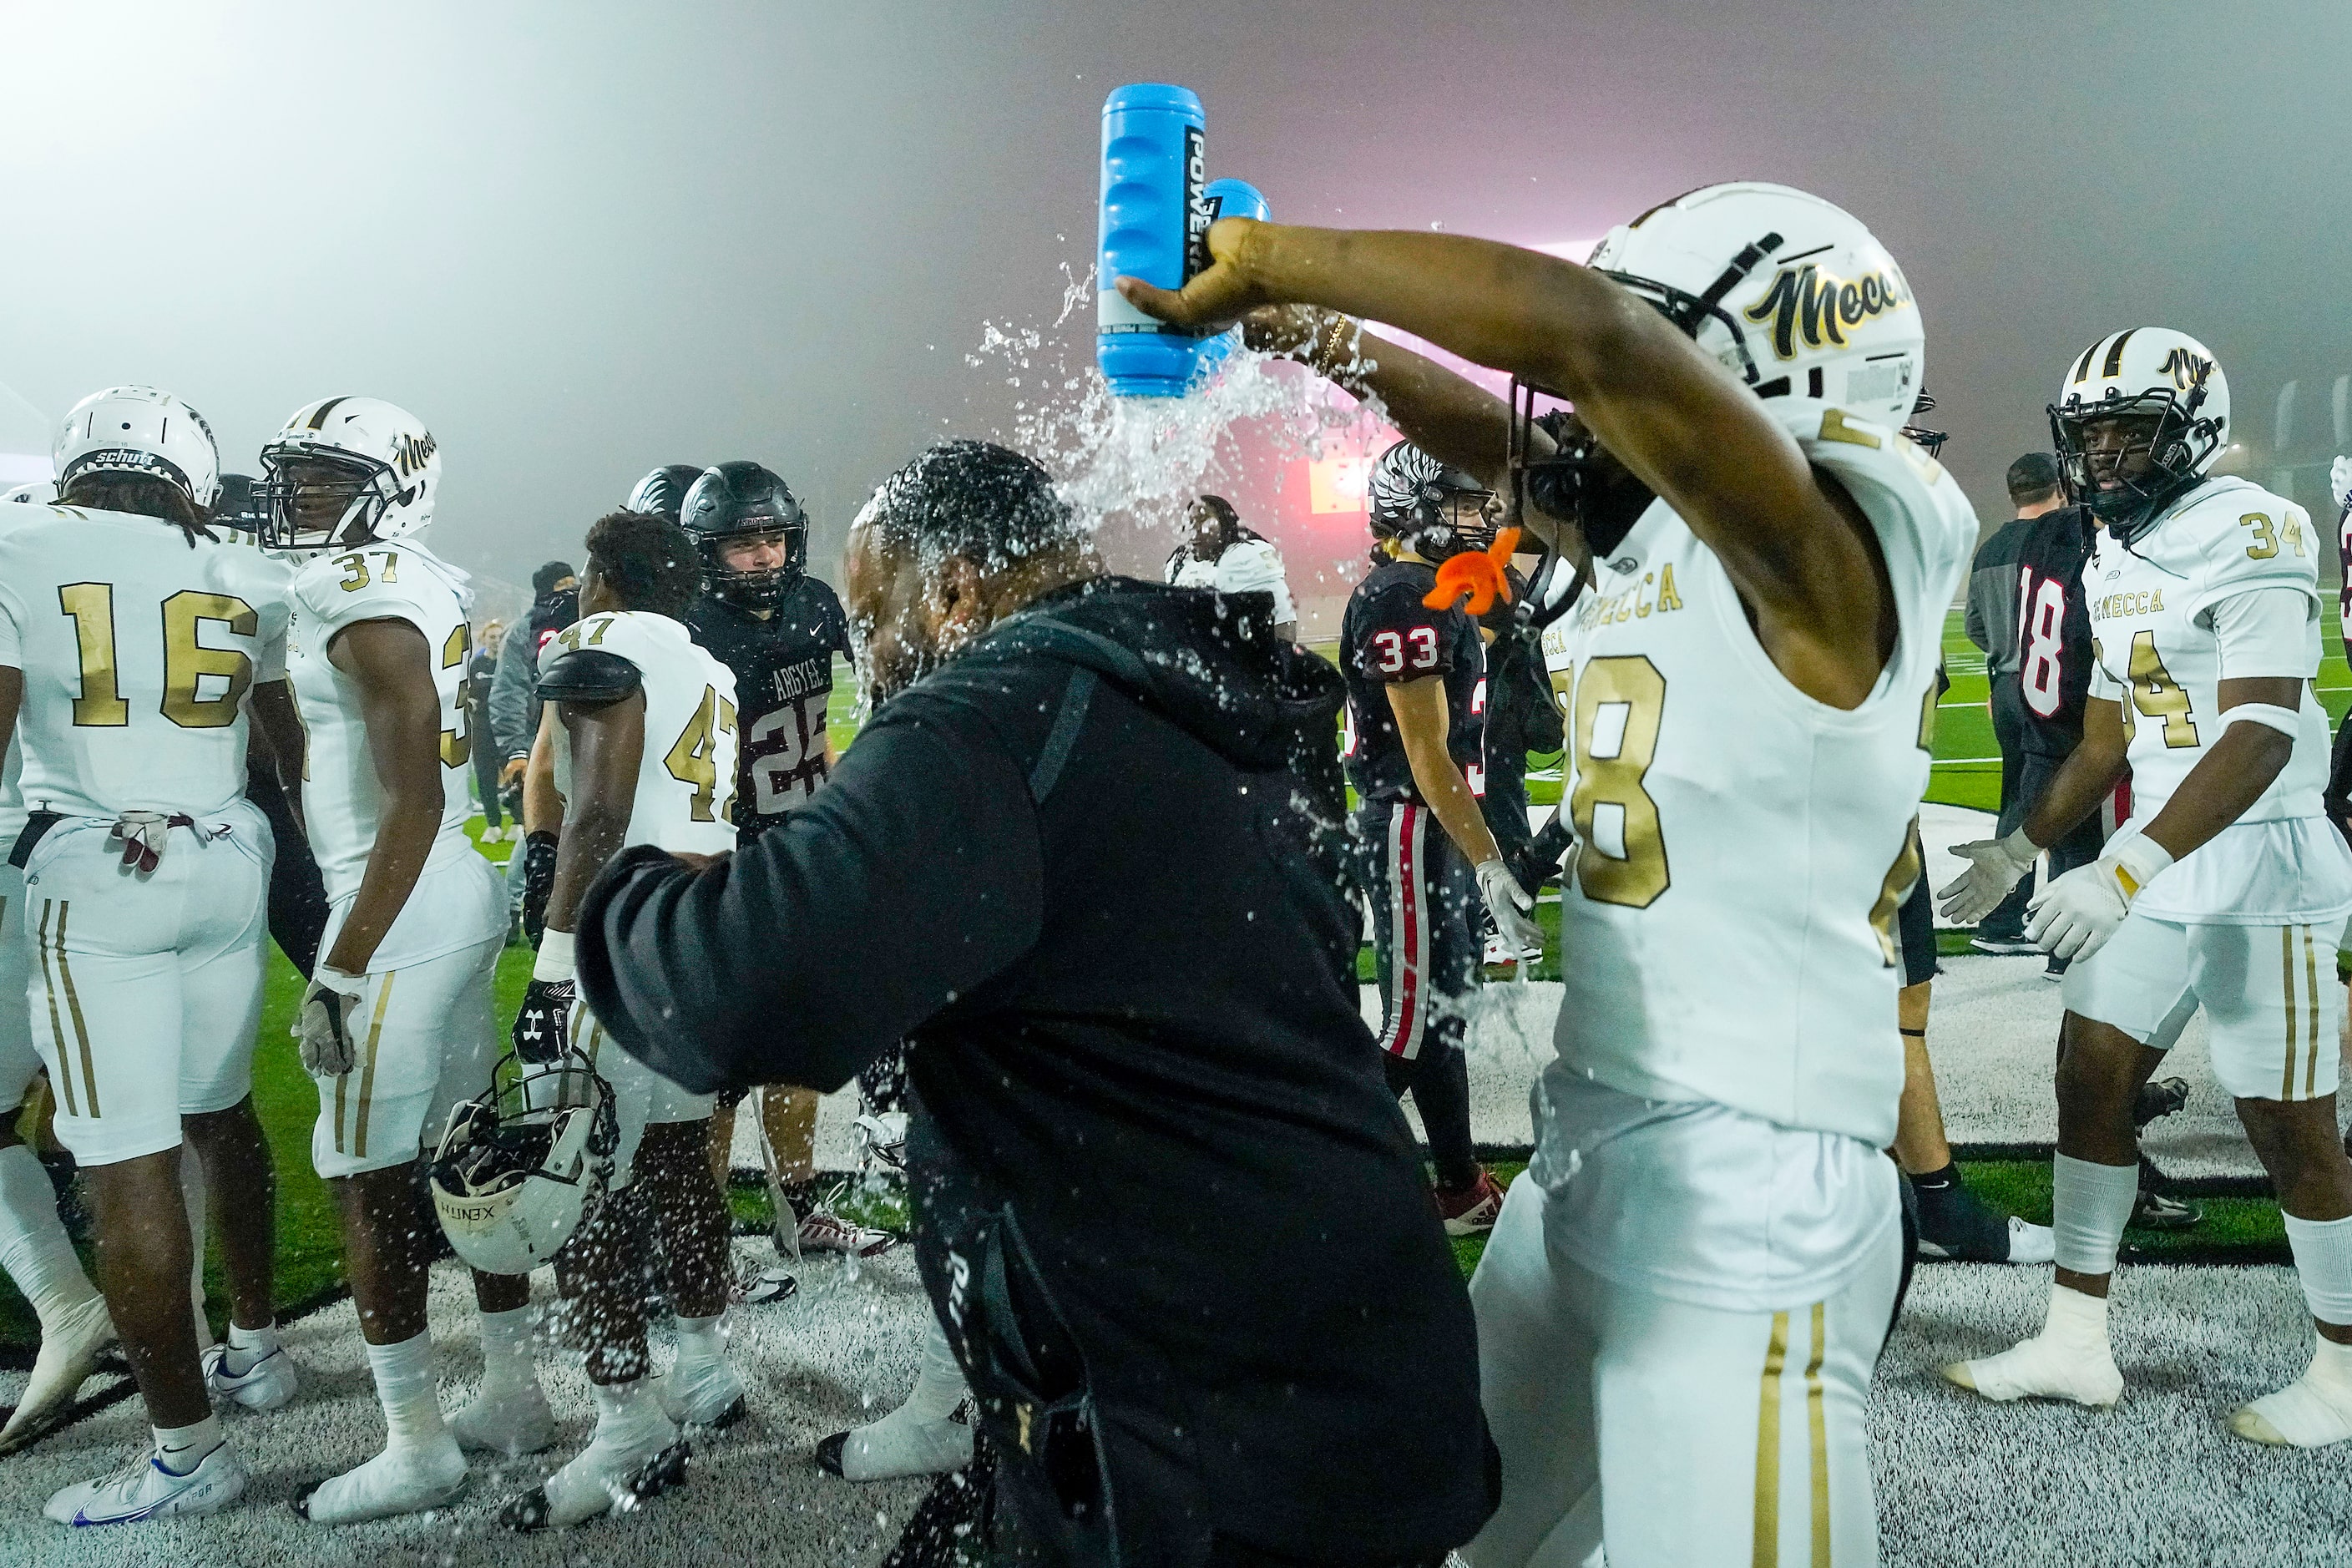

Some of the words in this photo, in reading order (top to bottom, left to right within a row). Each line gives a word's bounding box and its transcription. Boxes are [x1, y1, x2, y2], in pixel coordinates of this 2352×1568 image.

[95, 449, 156, 466] schutt
[2239, 511, 2306, 560] 34
[332, 551, 398, 593] 37
[2102, 588, 2165, 620] MECCA
[58, 581, 259, 728] 16
[559, 618, 615, 652] 47
[1373, 625, 1439, 673] 33
[2017, 564, 2065, 717] 18
[772, 657, 824, 702] ARGYLE
[1564, 654, 1671, 910] 8
